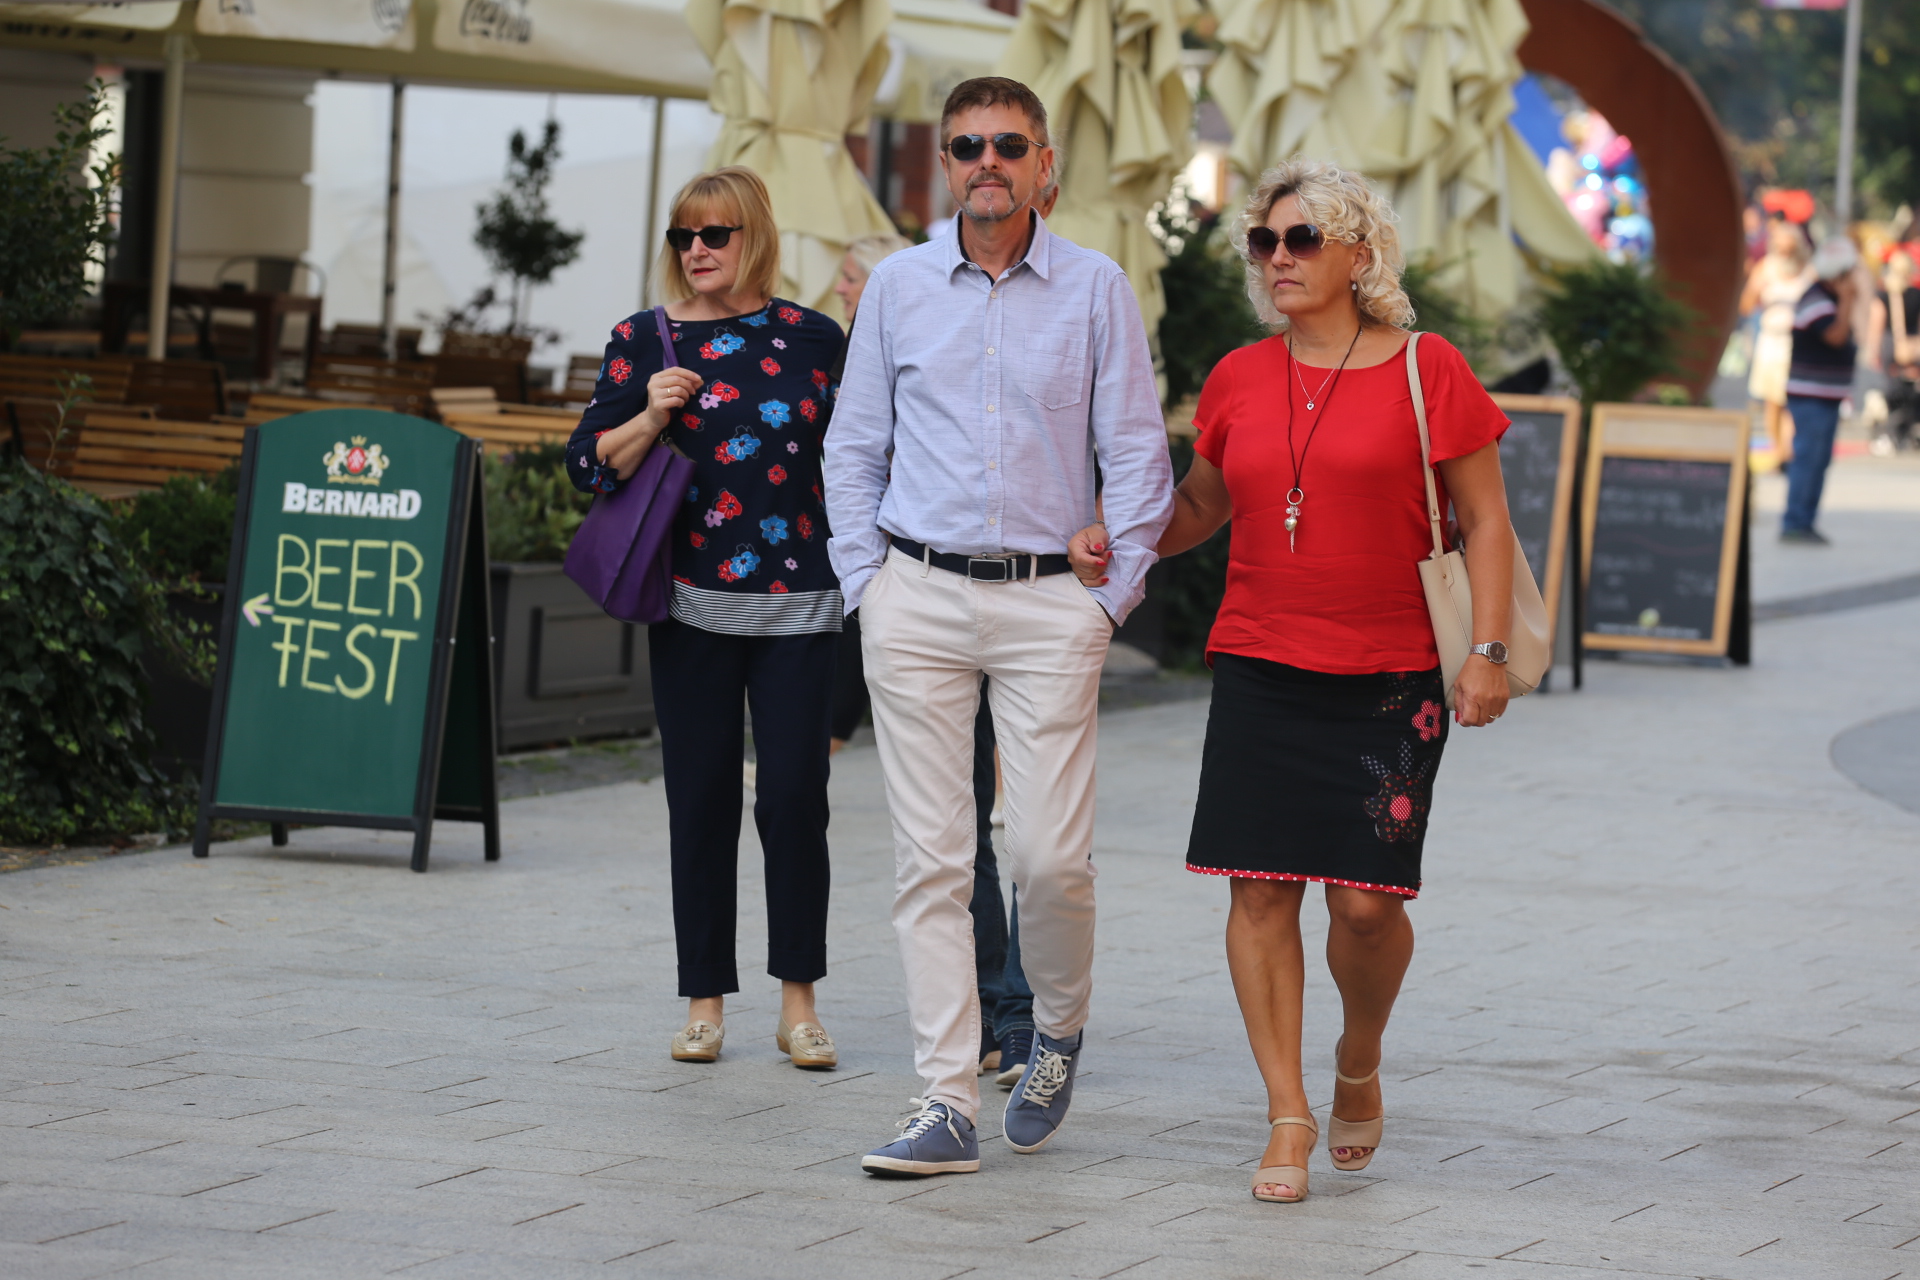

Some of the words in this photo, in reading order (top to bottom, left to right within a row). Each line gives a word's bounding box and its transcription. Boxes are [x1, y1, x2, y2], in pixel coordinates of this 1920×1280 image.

[282, 482, 422, 520] BERNARD
[274, 534, 424, 620] BEER
[271, 615, 420, 705] FEST
